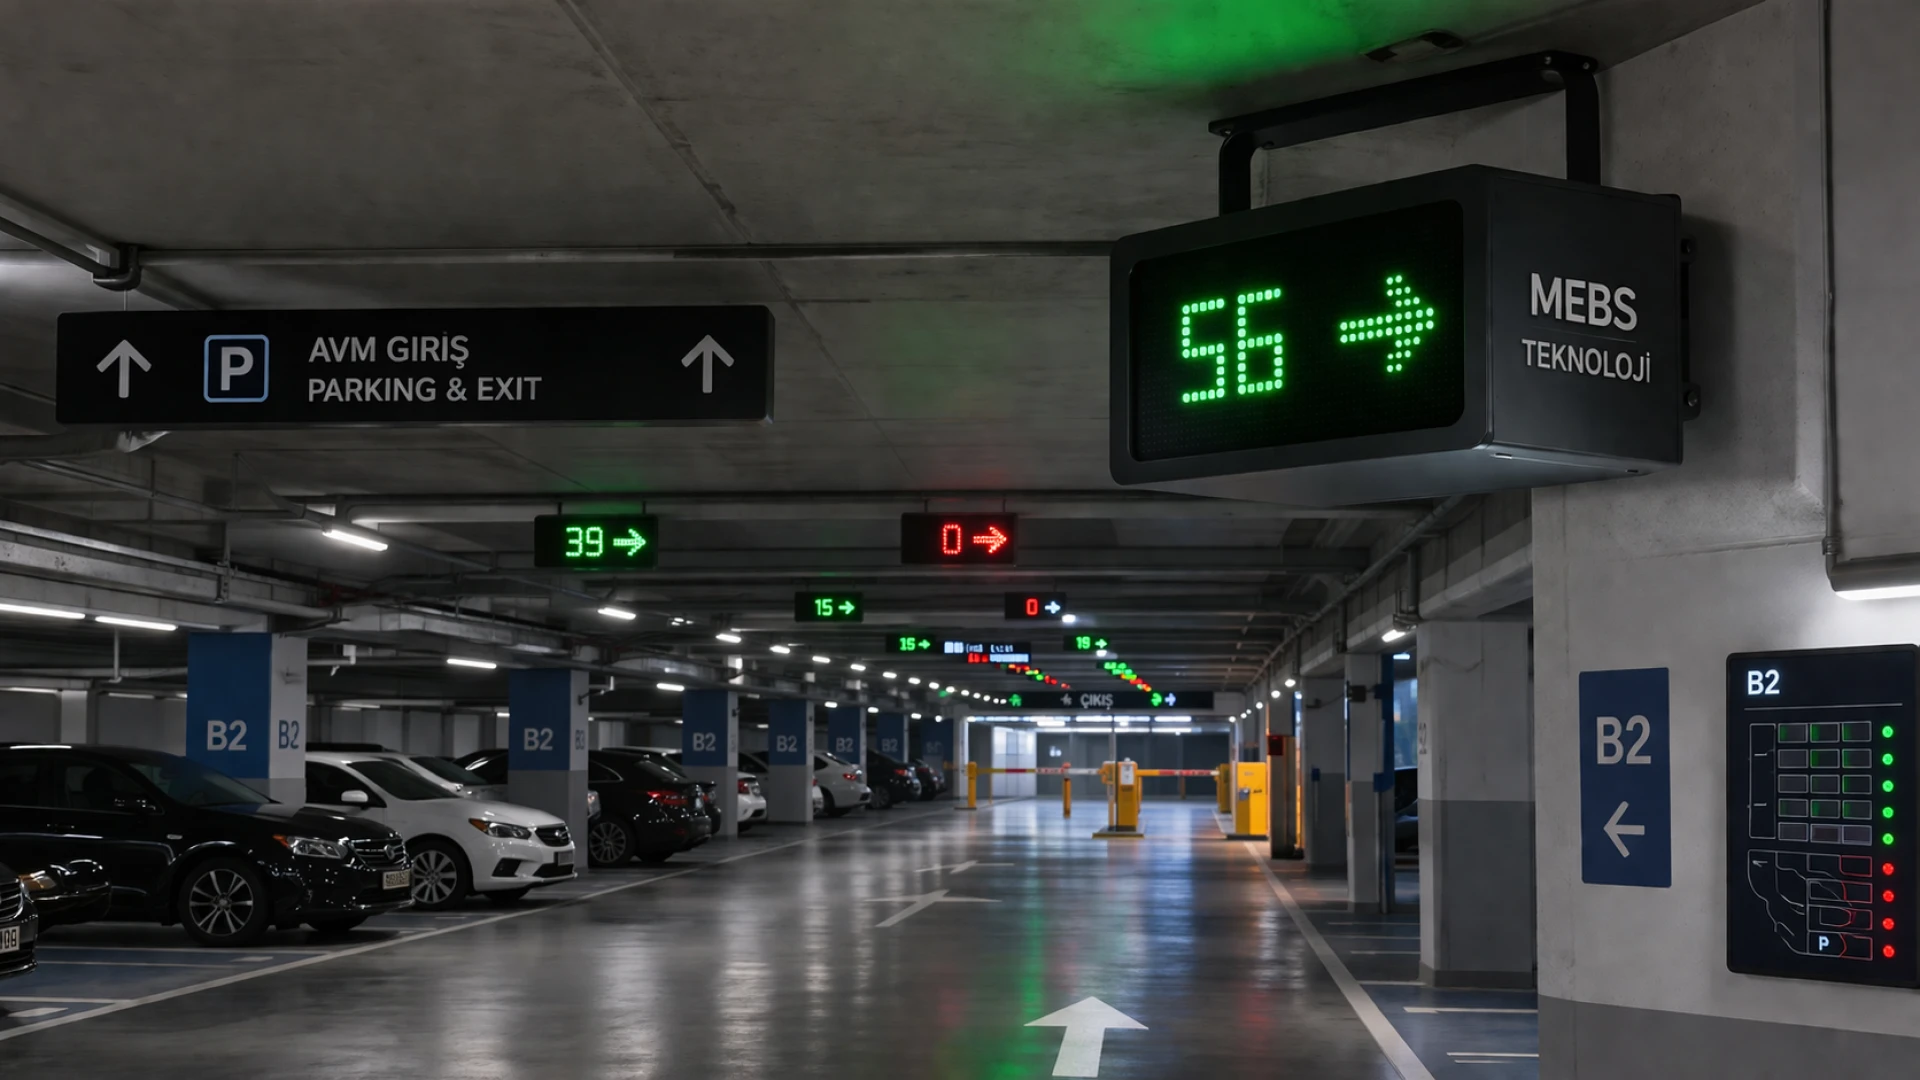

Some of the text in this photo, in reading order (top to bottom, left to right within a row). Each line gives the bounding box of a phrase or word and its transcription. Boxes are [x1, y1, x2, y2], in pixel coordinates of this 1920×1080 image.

[1531, 272, 1637, 331] MEBS
[308, 336, 376, 362] AVM
[1182, 287, 1283, 403] 56
[220, 346, 254, 391] P
[308, 376, 543, 402] PARKING & EXIT
[565, 526, 604, 557] 39
[942, 523, 962, 555] 0
[814, 598, 833, 617] 15
[1026, 598, 1039, 616] 0
[1746, 670, 1781, 695] B2
[206, 719, 248, 751] B2
[278, 719, 300, 750] B2
[523, 727, 554, 751] B2
[692, 732, 716, 752] B2
[776, 735, 798, 753] B2
[835, 737, 854, 753] B2
[1596, 714, 1652, 765] B2
[1818, 937, 1830, 951] P
